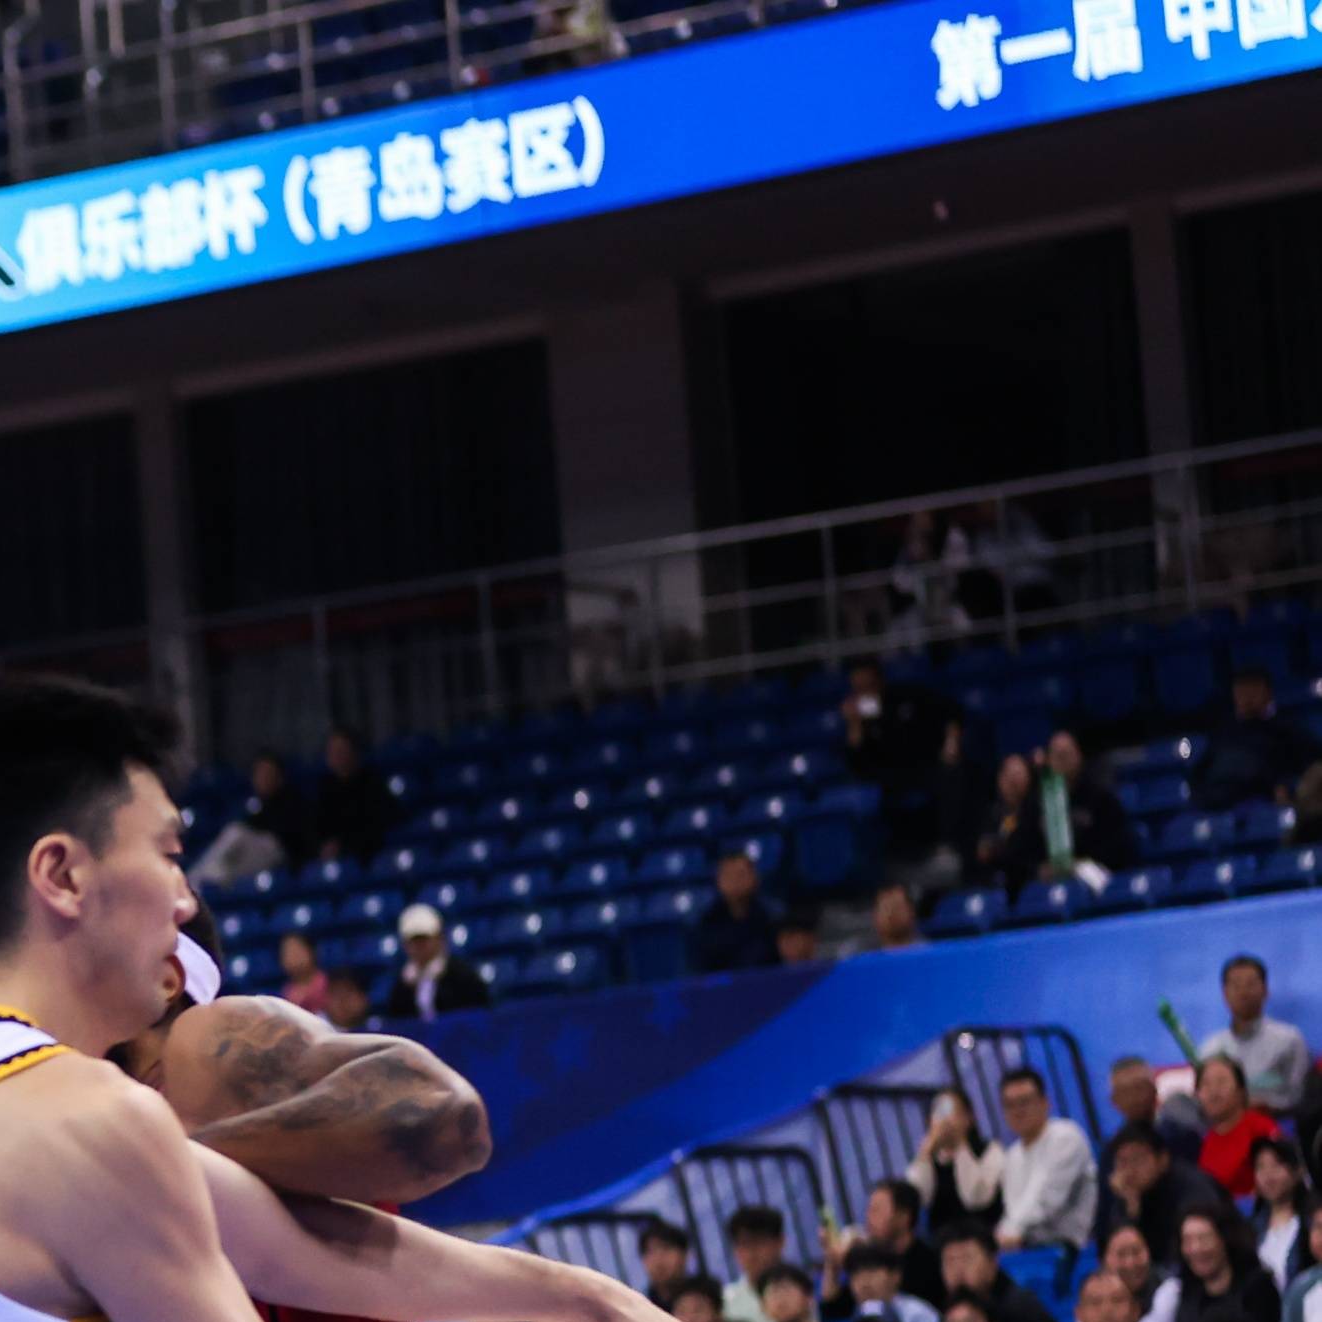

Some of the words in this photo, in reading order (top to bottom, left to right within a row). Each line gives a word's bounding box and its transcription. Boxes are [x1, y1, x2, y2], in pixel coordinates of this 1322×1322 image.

[931, 0, 1143, 111] 第一届
[1163, 0, 1322, 61] 中国
